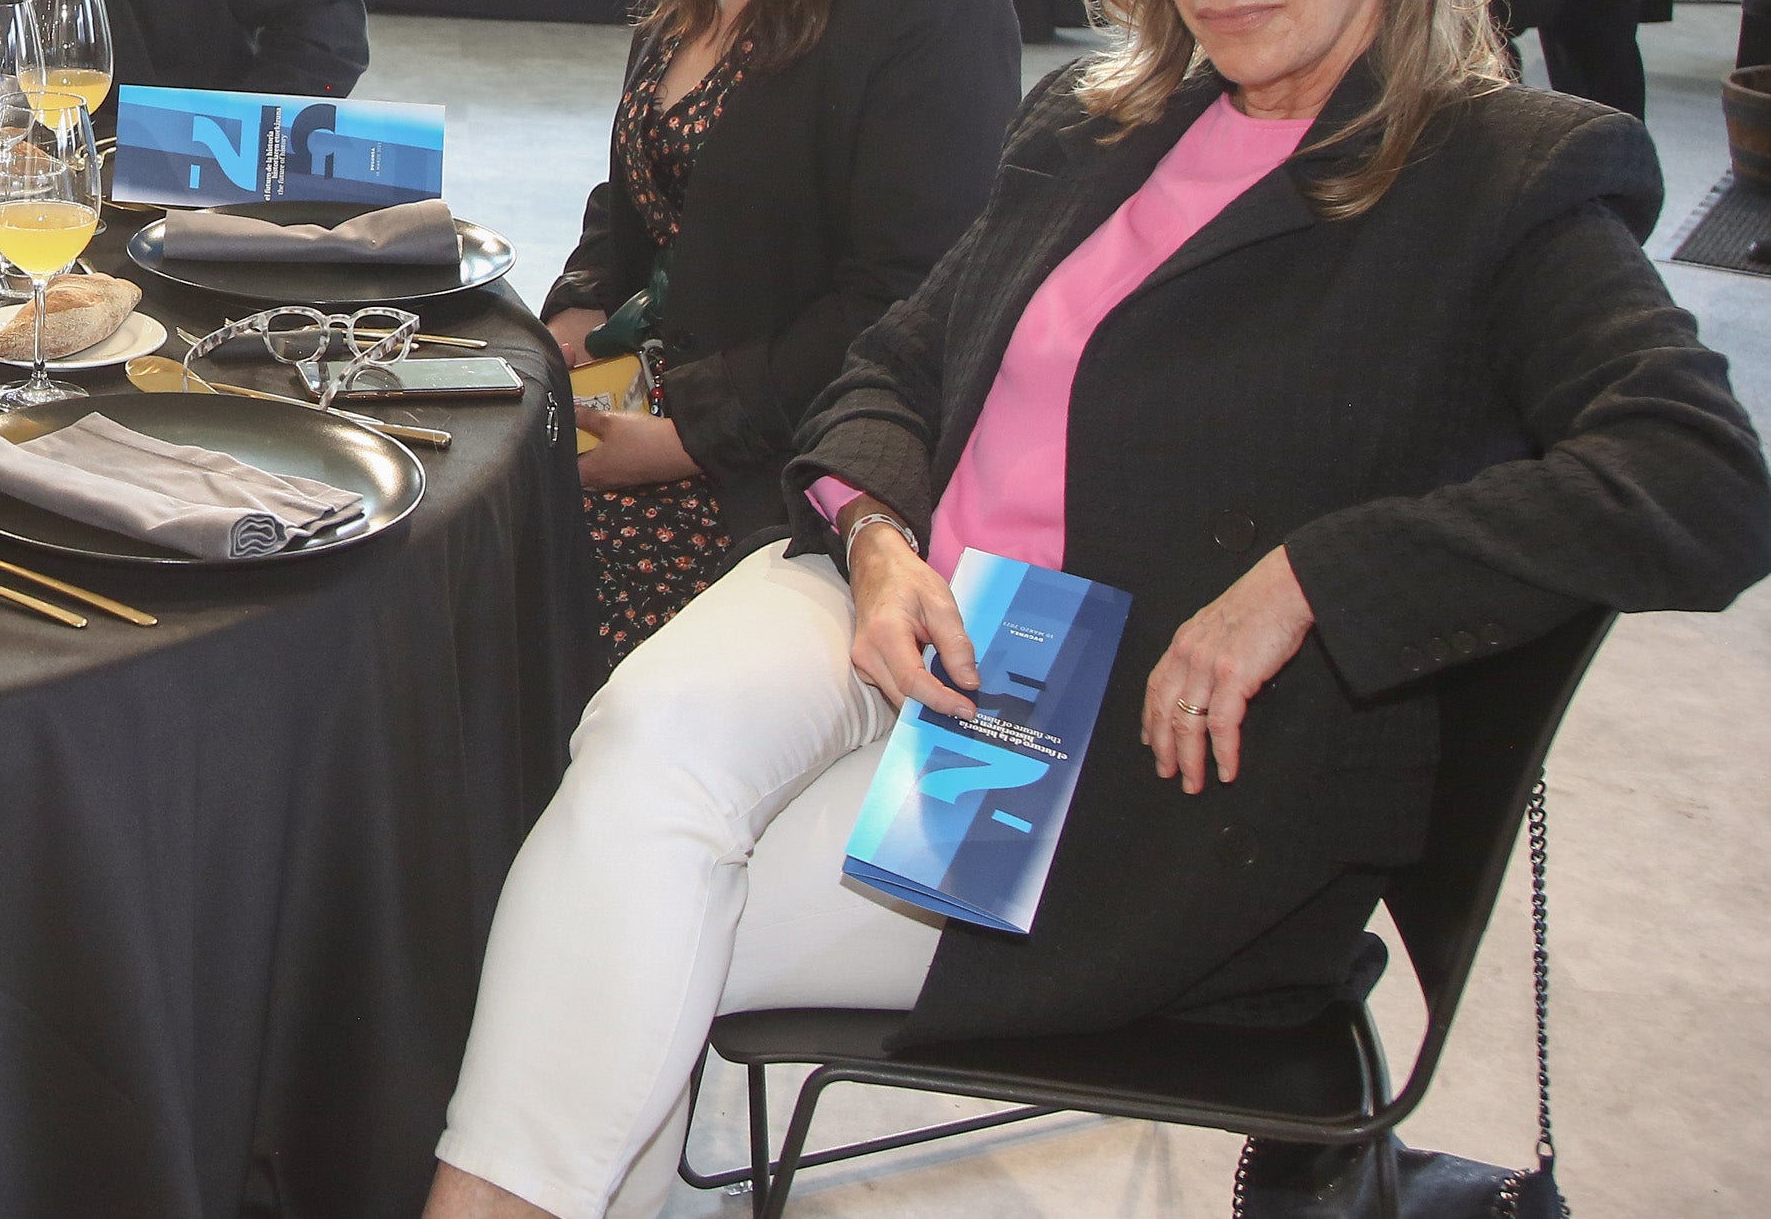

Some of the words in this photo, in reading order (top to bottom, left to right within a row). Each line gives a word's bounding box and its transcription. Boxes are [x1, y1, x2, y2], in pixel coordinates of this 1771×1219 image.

[266, 130, 274, 156] historia
[279, 134, 288, 156] history
[265, 163, 273, 172] de
[264, 172, 272, 194] futuro
[976, 712, 1001, 726] histo
[1001, 719, 1013, 728] of
[958, 720, 998, 739] historia
[979, 720, 1035, 742] historiaren
[1013, 724, 1045, 739] future
[998, 733, 1009, 742] la
[1009, 736, 1023, 746] de
[1044, 734, 1062, 744] the
[1022, 740, 1057, 758] futuro
[1056, 752, 1068, 760] el
